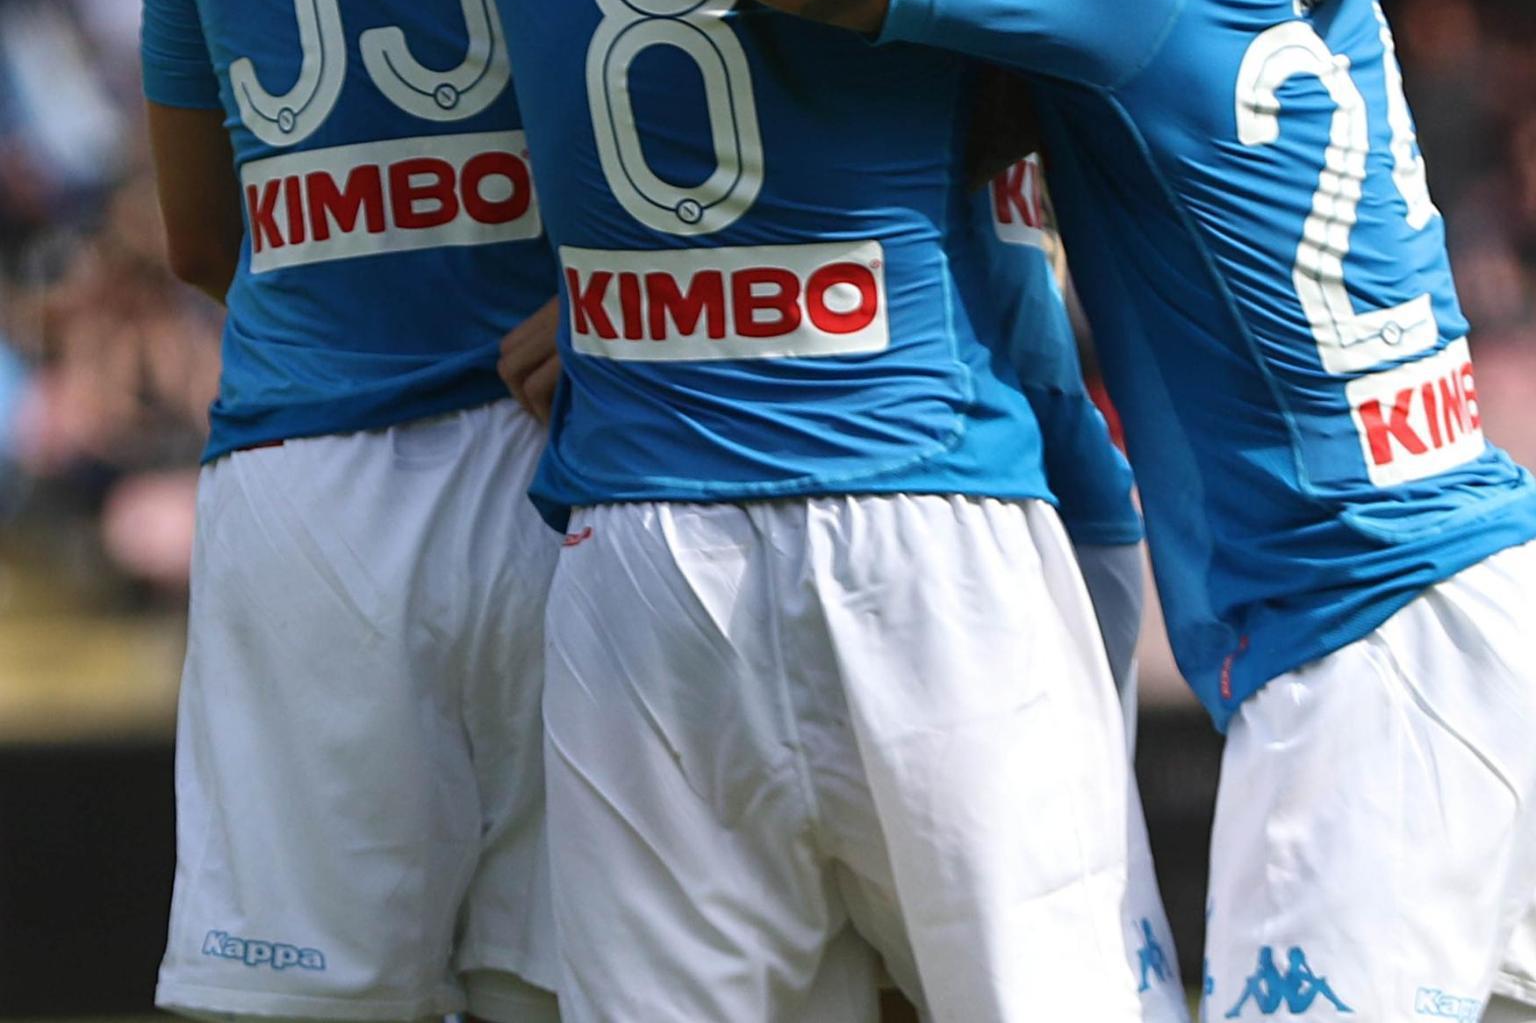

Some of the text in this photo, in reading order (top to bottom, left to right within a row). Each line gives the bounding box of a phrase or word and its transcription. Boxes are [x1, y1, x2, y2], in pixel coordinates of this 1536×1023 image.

[246, 151, 532, 254] KIMBO
[565, 262, 879, 342] KIMBO
[202, 929, 326, 970] Kappa
